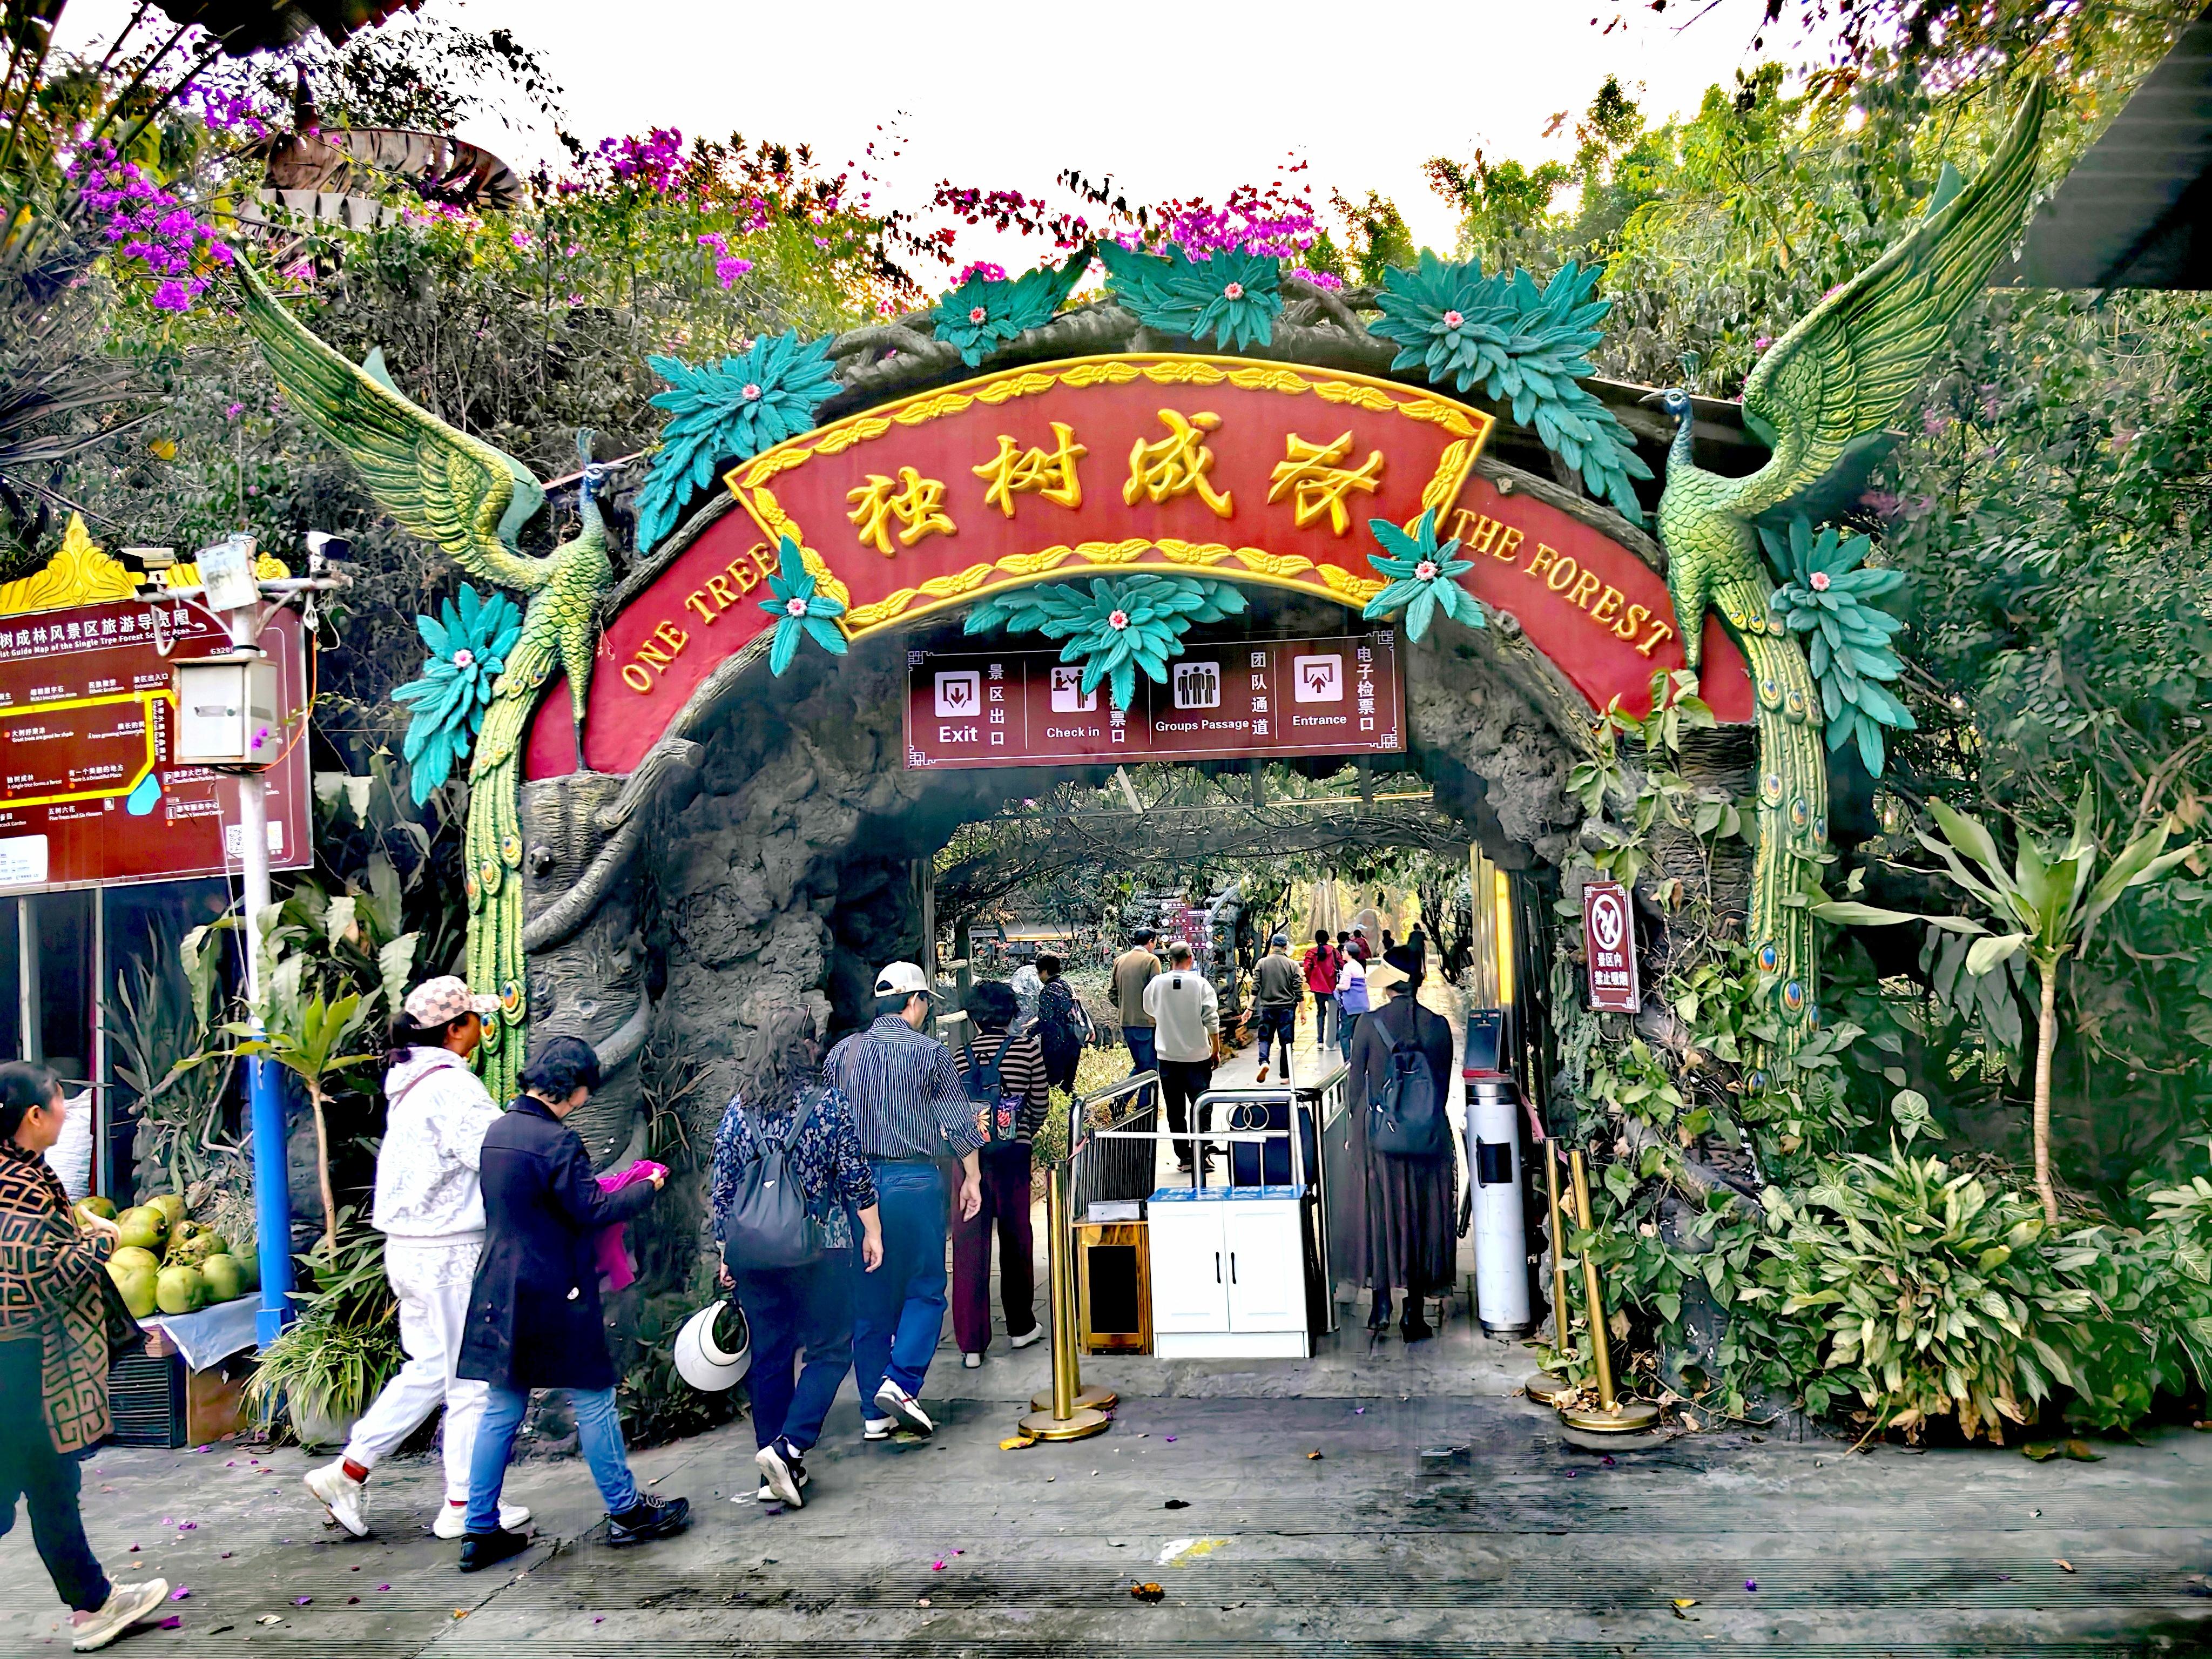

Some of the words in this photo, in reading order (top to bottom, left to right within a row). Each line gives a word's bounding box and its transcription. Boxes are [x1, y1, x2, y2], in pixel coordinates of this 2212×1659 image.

[1448, 508, 1525, 563] THE
[1523, 543, 1674, 658] FOREST
[622, 620, 690, 693] ONE
[685, 542, 778, 625] TREE
[11, 648, 32, 657] Guide
[34, 645, 49, 653] Map
[51, 643, 59, 651] of
[60, 642, 73, 650] the
[75, 639, 98, 648] Single
[100, 636, 117, 645] Tree
[119, 633, 144, 643] Forest
[146, 630, 171, 639] Scic
[210, 646, 233, 656] G320
[1251, 652, 1269, 735] 团队通道
[1357, 646, 1375, 731] 电子检票口
[988, 664, 1004, 745] 景区出口
[1156, 721, 1198, 732] Groups
[1202, 719, 1249, 730] Passage
[1292, 716, 1347, 726] Entrance
[939, 725, 978, 743] Exit
[1047, 727, 1085, 738] Check
[1088, 727, 1100, 737] in
[1597, 952, 1622, 967] 景区内
[1594, 970, 1628, 987] 禁止吸烟
